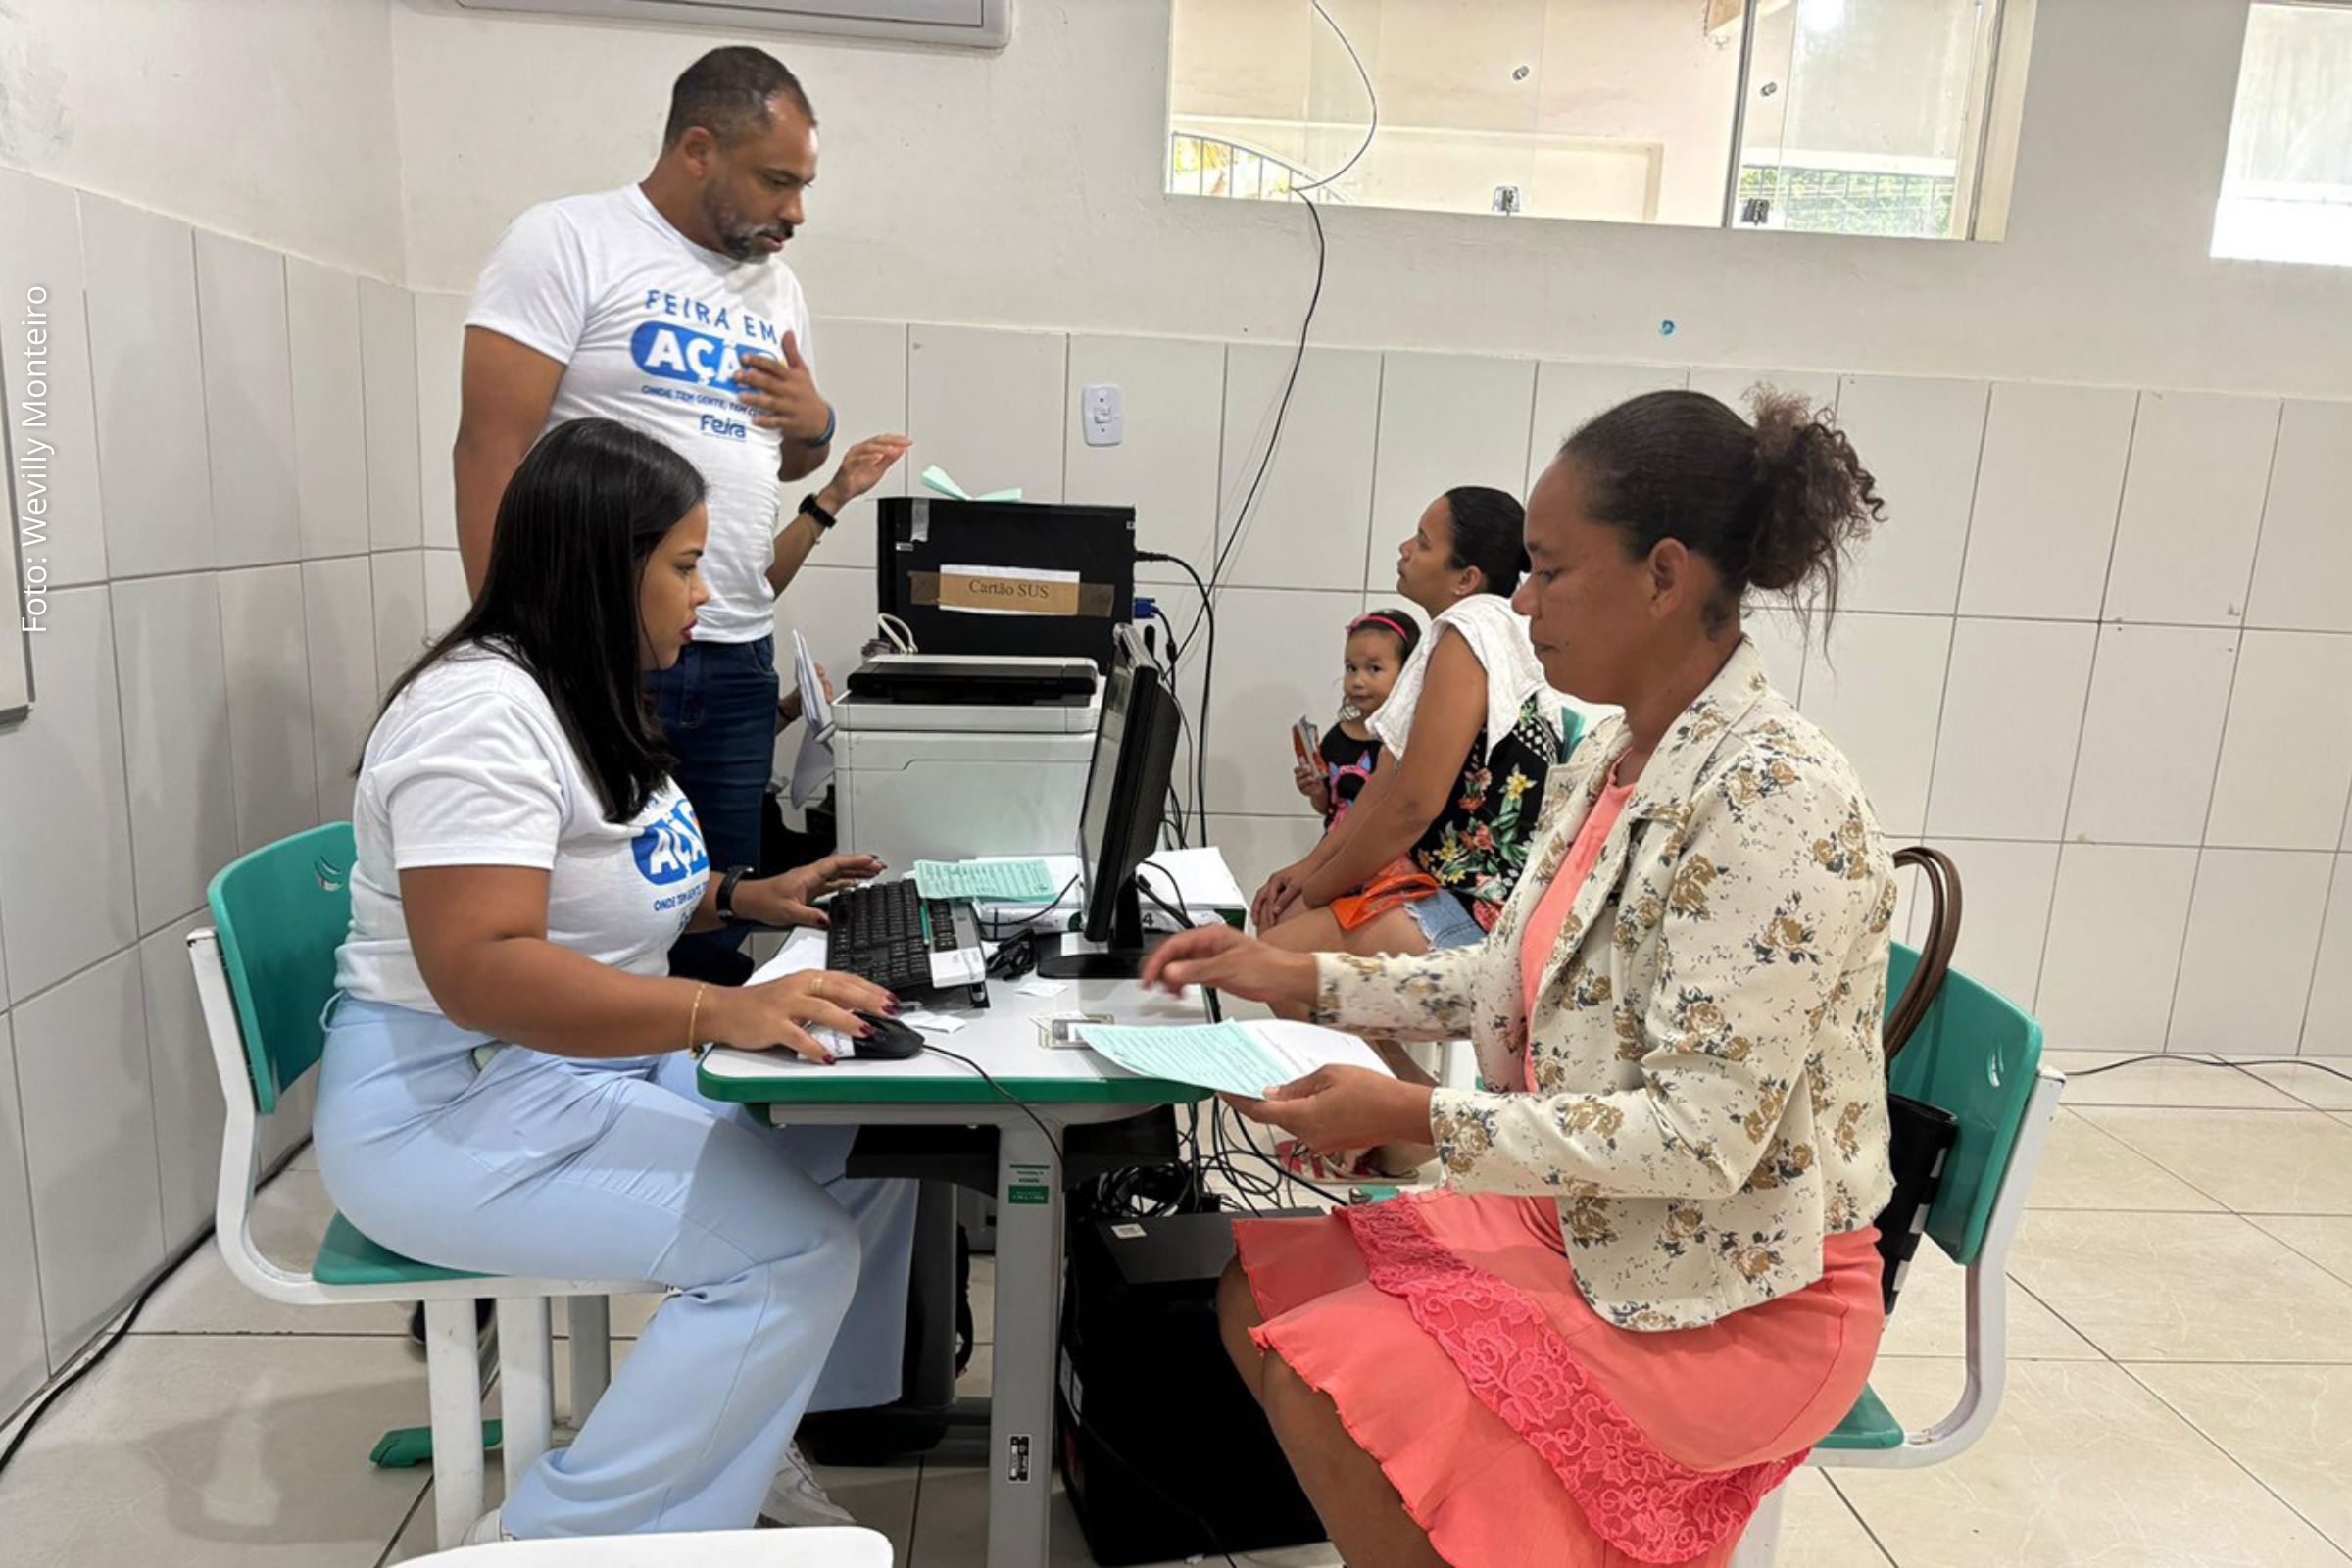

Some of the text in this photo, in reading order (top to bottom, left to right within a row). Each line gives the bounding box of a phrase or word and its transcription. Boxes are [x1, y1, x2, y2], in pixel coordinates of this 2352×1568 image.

[645, 289, 778, 345] FEIRA EM
[643, 327, 778, 386] AÇÃ
[700, 413, 747, 439] Feira
[968, 578, 1050, 599] Cartão SUS
